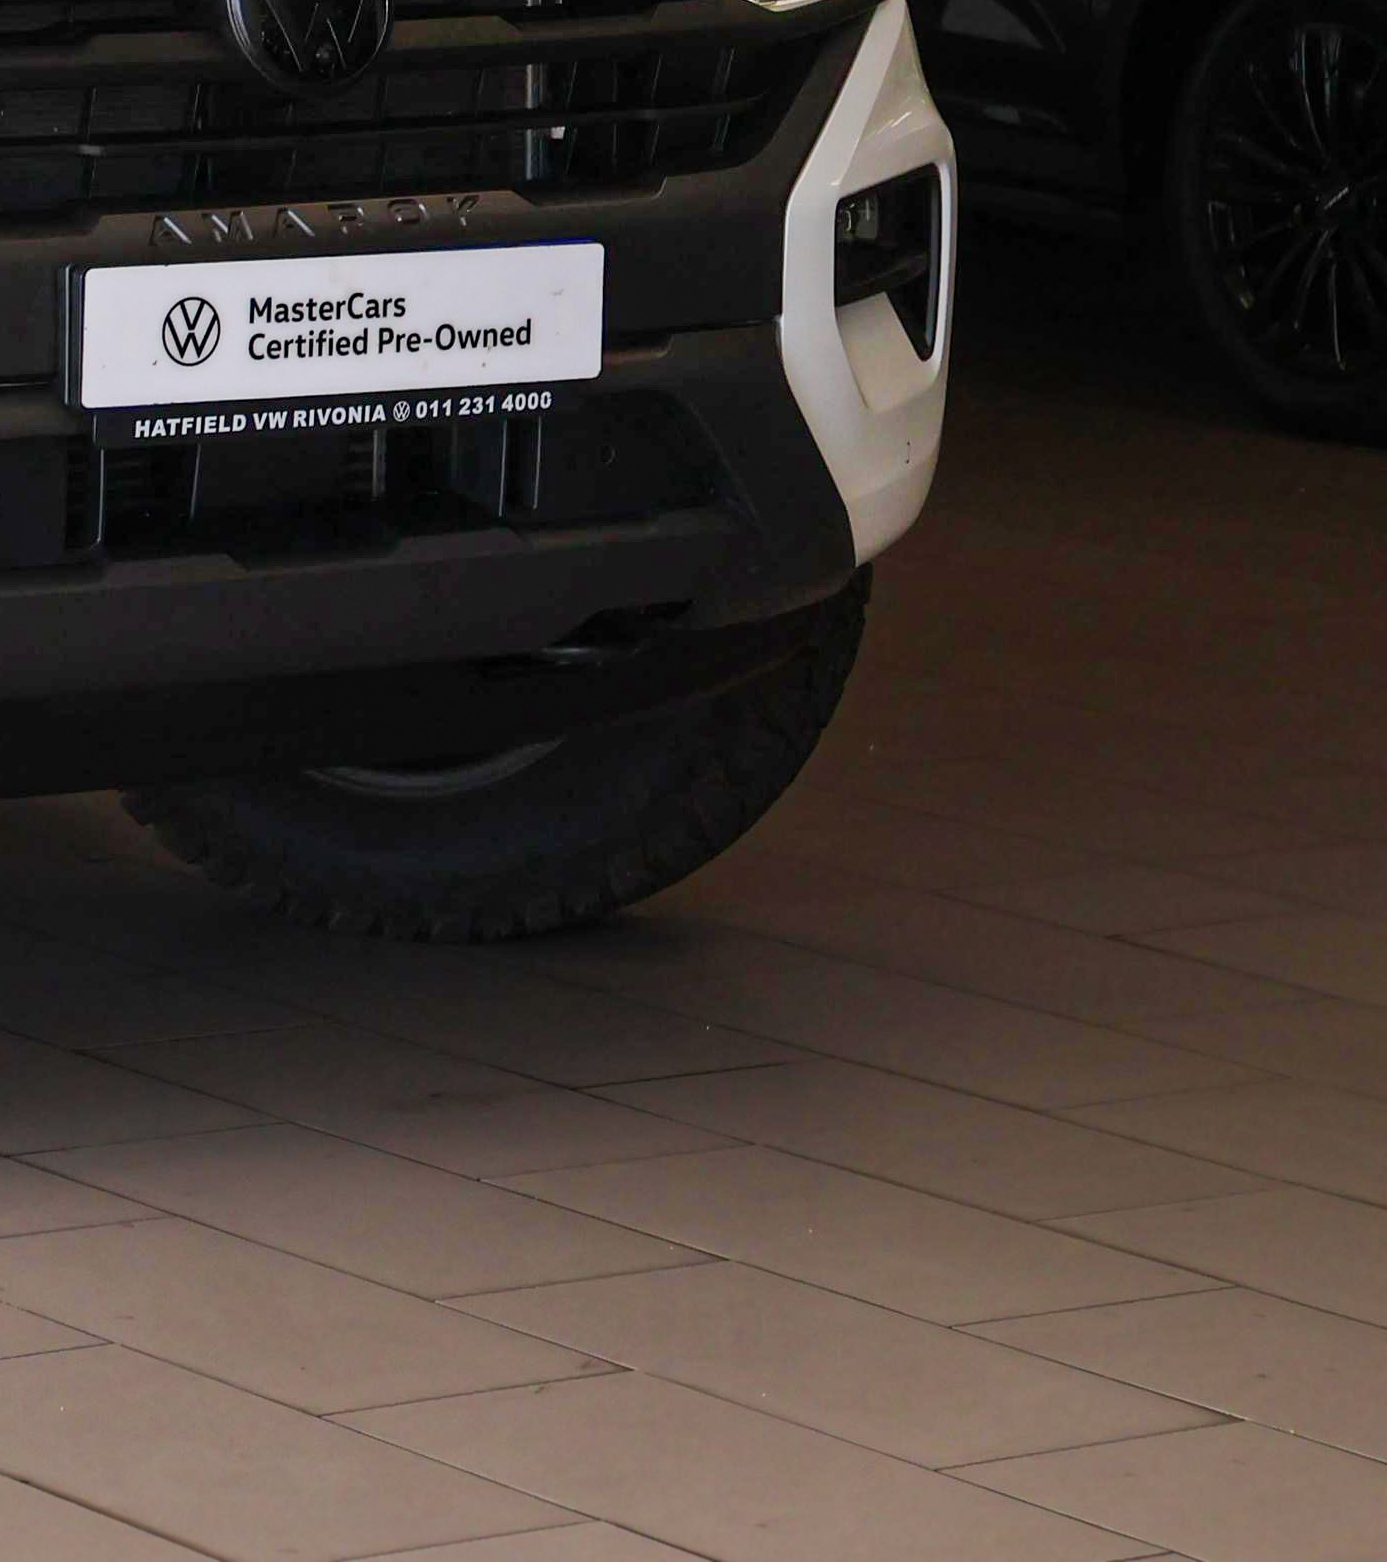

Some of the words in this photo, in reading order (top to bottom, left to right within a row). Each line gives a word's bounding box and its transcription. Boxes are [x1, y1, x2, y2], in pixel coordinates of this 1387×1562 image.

[248, 292, 407, 324] MasterCars
[247, 327, 369, 361] Certified
[377, 318, 532, 355] Pre-Owned
[134, 413, 247, 439] HATFIELD
[252, 411, 288, 431] VW
[292, 406, 387, 428] RIVONIA
[415, 398, 452, 420] 011
[458, 395, 495, 417] 231
[501, 391, 552, 412] 4000
